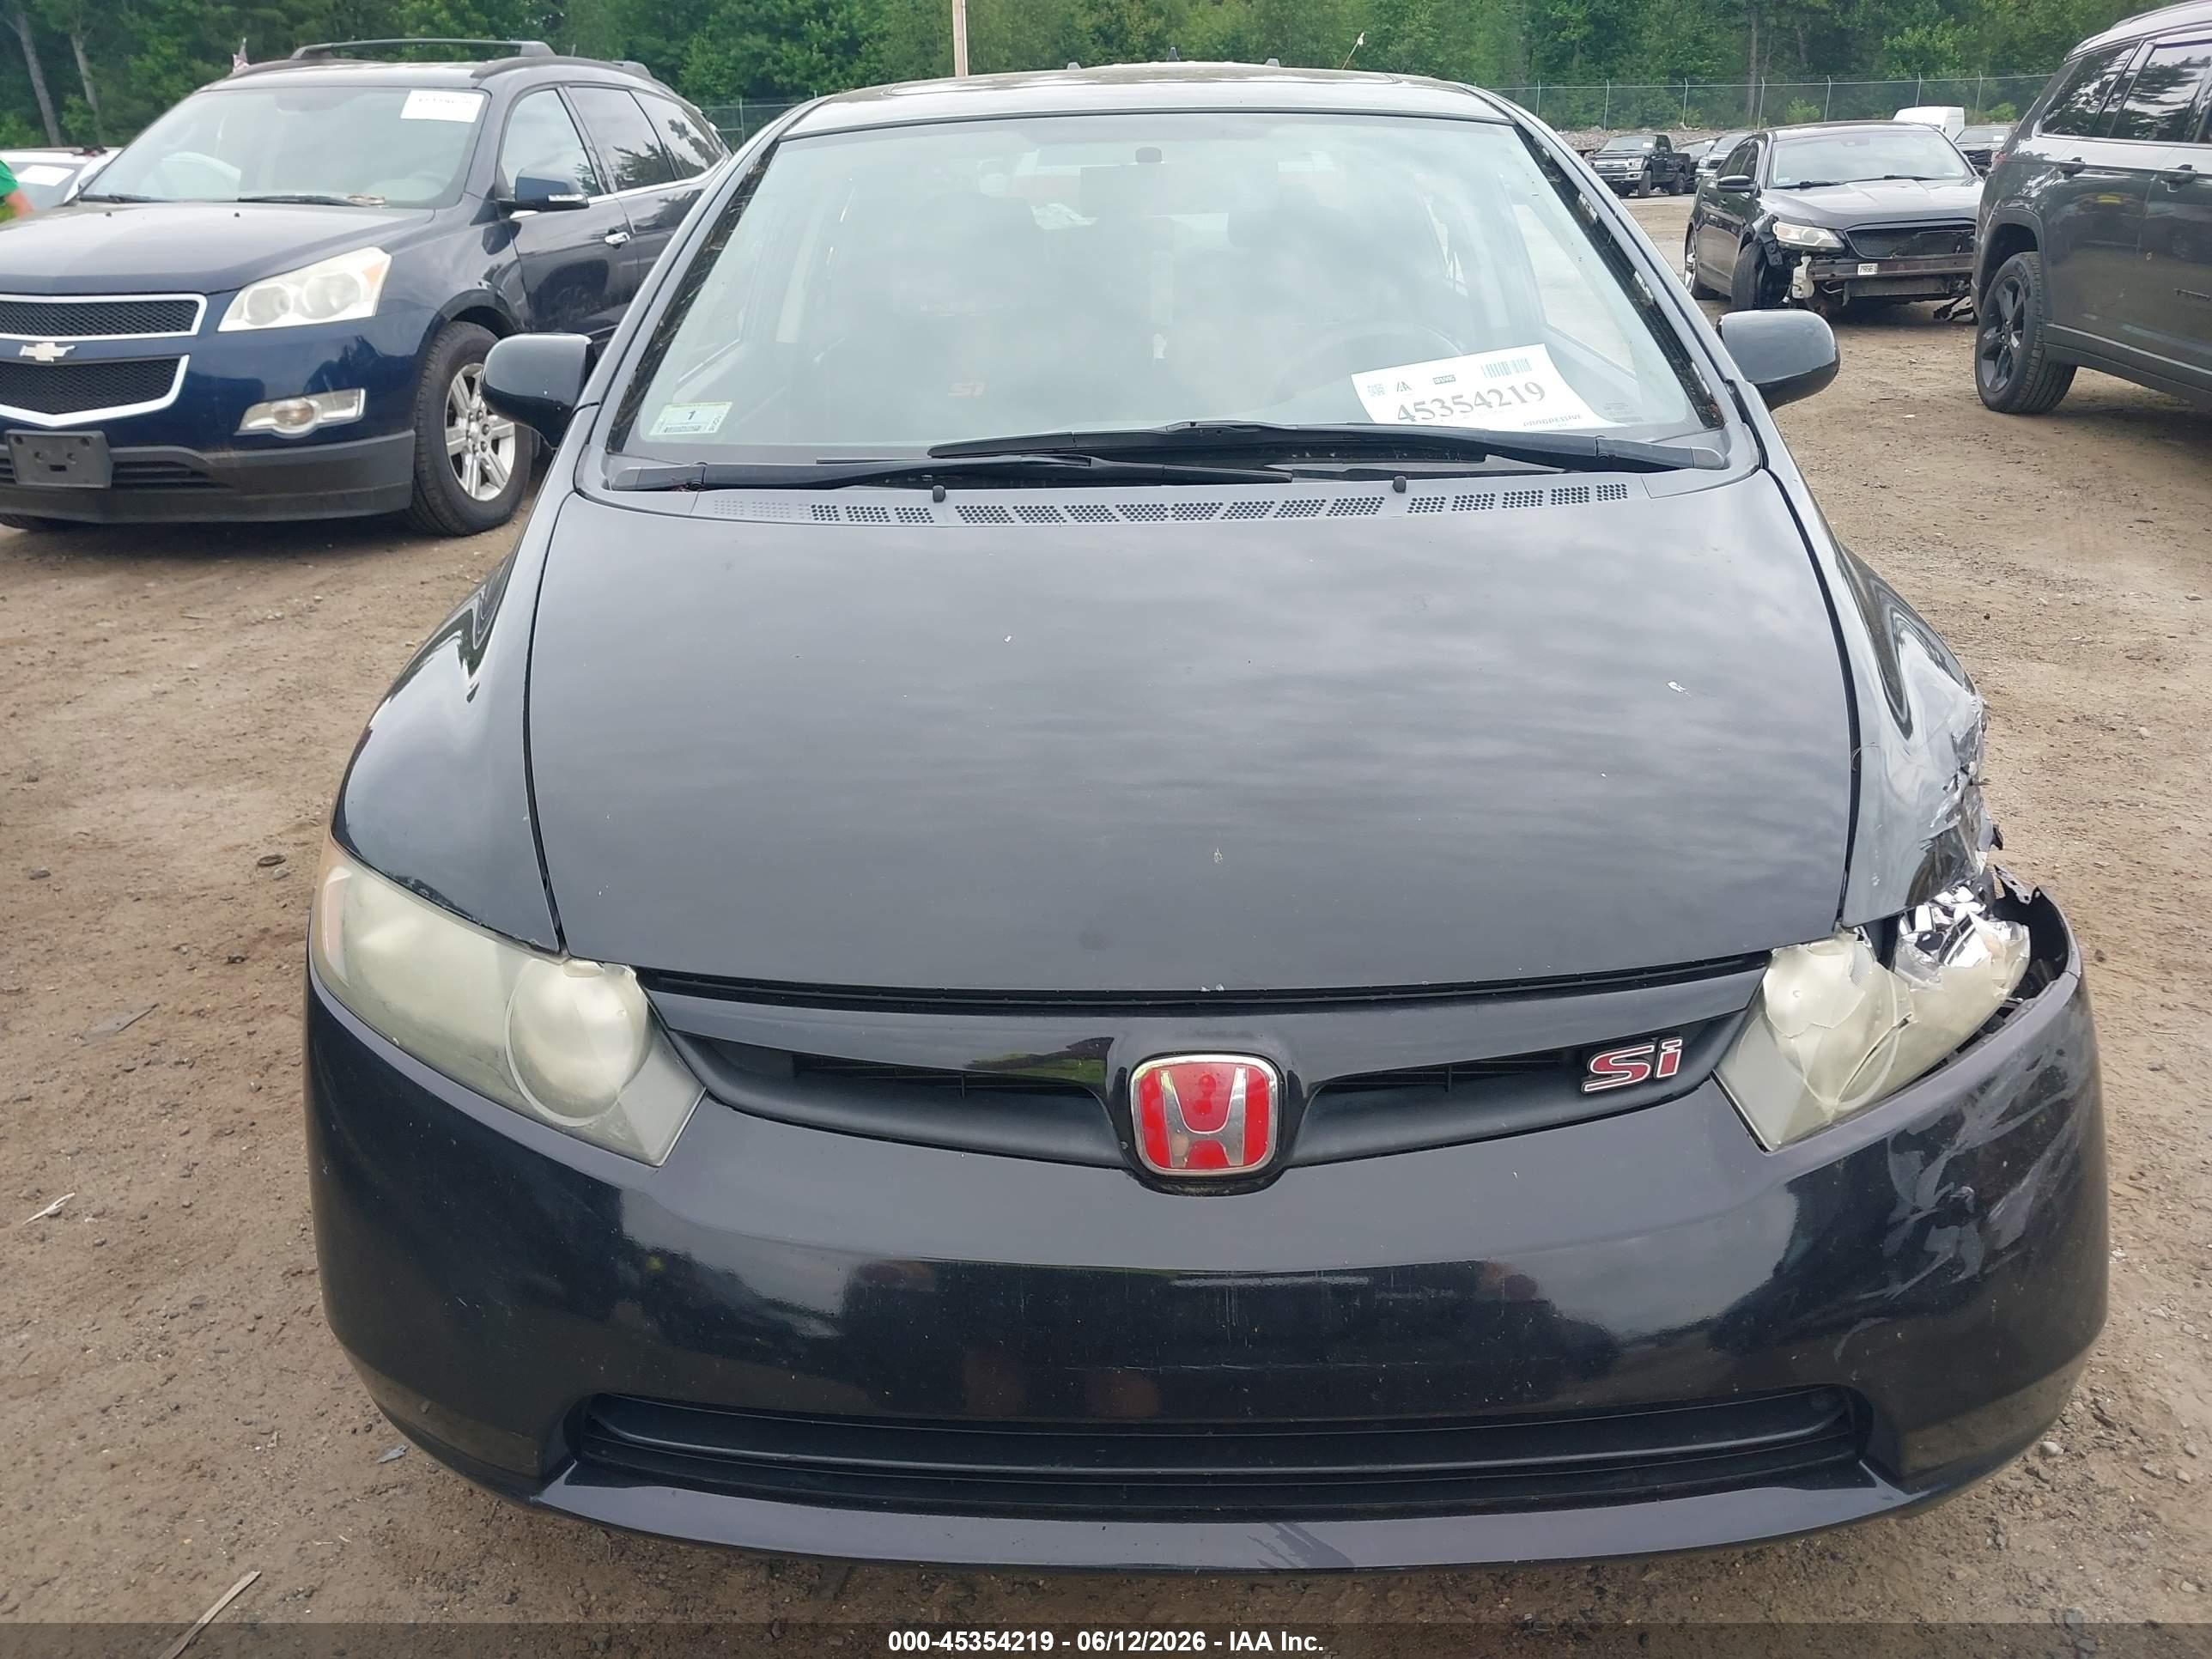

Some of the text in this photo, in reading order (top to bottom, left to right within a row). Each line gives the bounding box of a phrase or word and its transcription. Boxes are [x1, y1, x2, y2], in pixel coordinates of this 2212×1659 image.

[688, 410, 696, 420] 1
[1397, 381, 1546, 422] 45354219
[1583, 1037, 1683, 1092] Si
